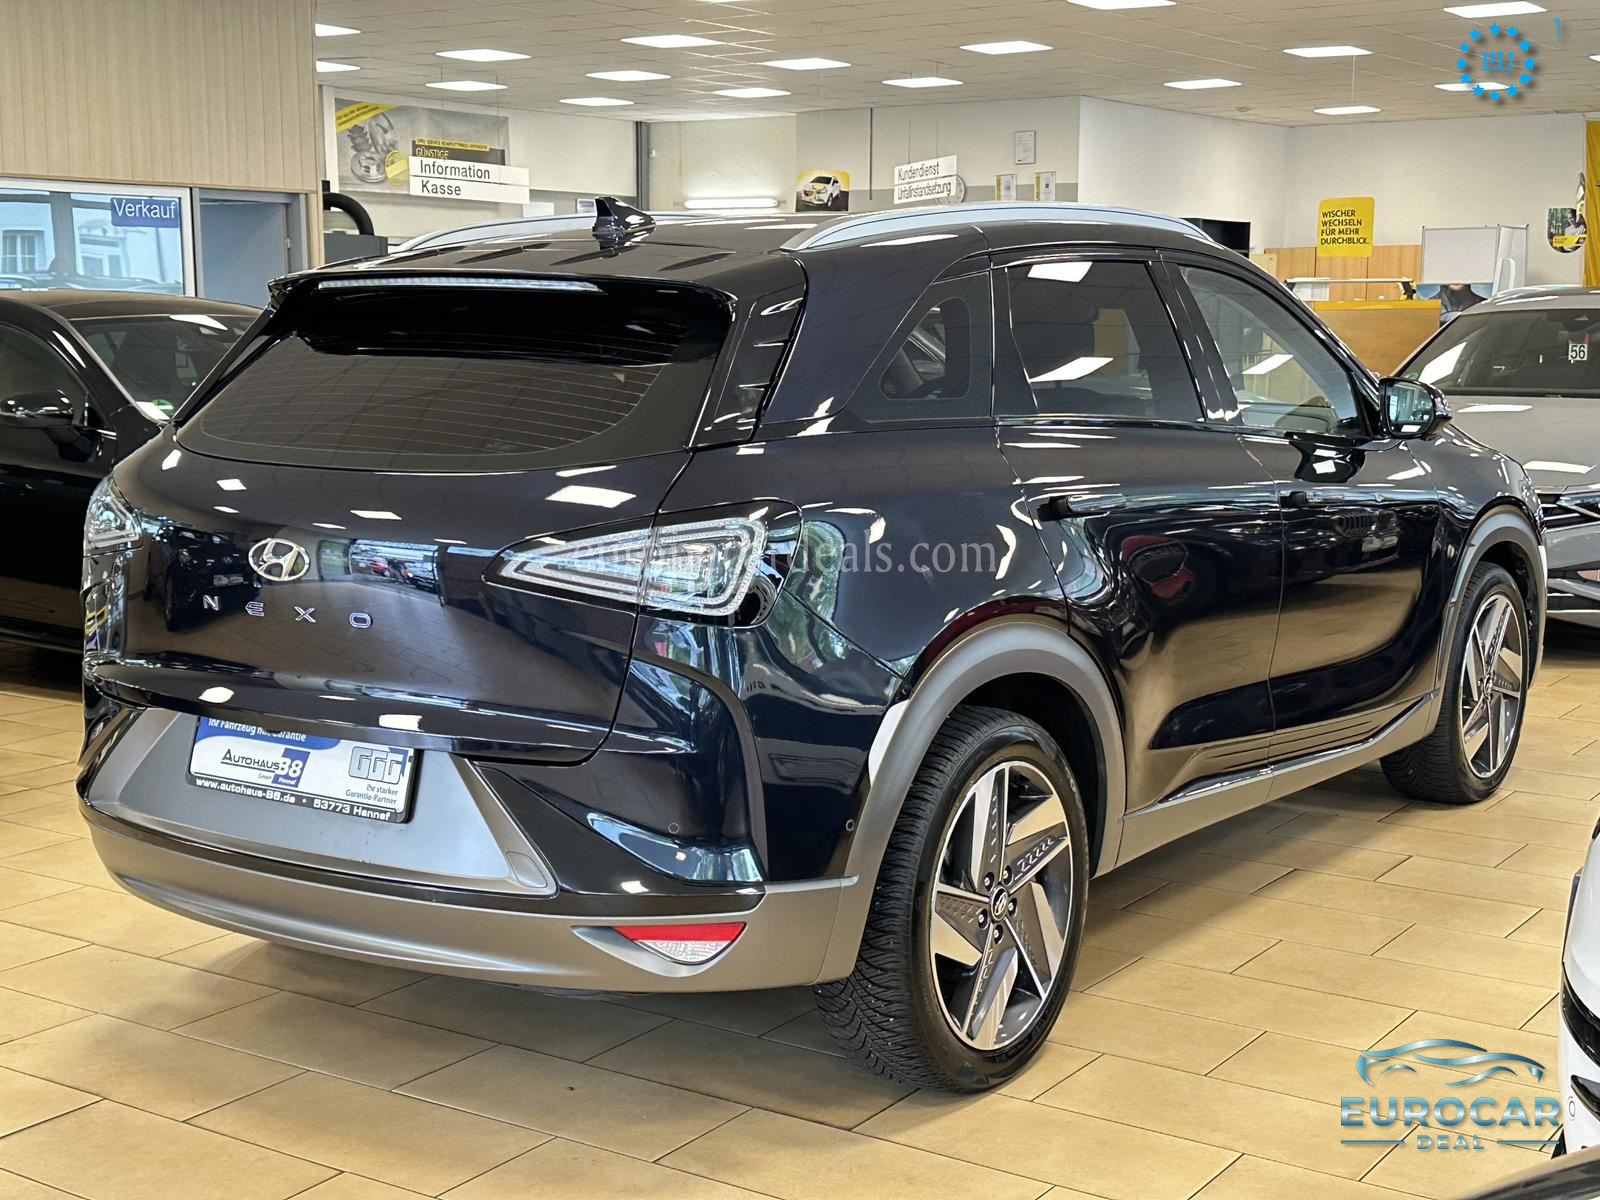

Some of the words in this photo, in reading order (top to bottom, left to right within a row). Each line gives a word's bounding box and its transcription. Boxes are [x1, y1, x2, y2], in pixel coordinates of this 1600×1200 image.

[416, 146, 448, 159] GÜNSTIGE
[420, 159, 490, 180] Information
[898, 162, 939, 181] Kundendienst
[421, 179, 461, 196] Kasse
[113, 198, 178, 219] Verkauf
[1322, 209, 1355, 218] WISCHER
[1321, 218, 1362, 227] WECHSELN
[1321, 227, 1335, 236] FÜR
[1570, 344, 1585, 359] 56
[202, 594, 373, 629] NEXO
[345, 789, 397, 805] Garantie-Partner
[377, 786, 398, 796] starker
[196, 778, 295, 803] www.autohaus-88.de
[313, 799, 350, 814] 53773
[353, 806, 390, 821] Hennef
